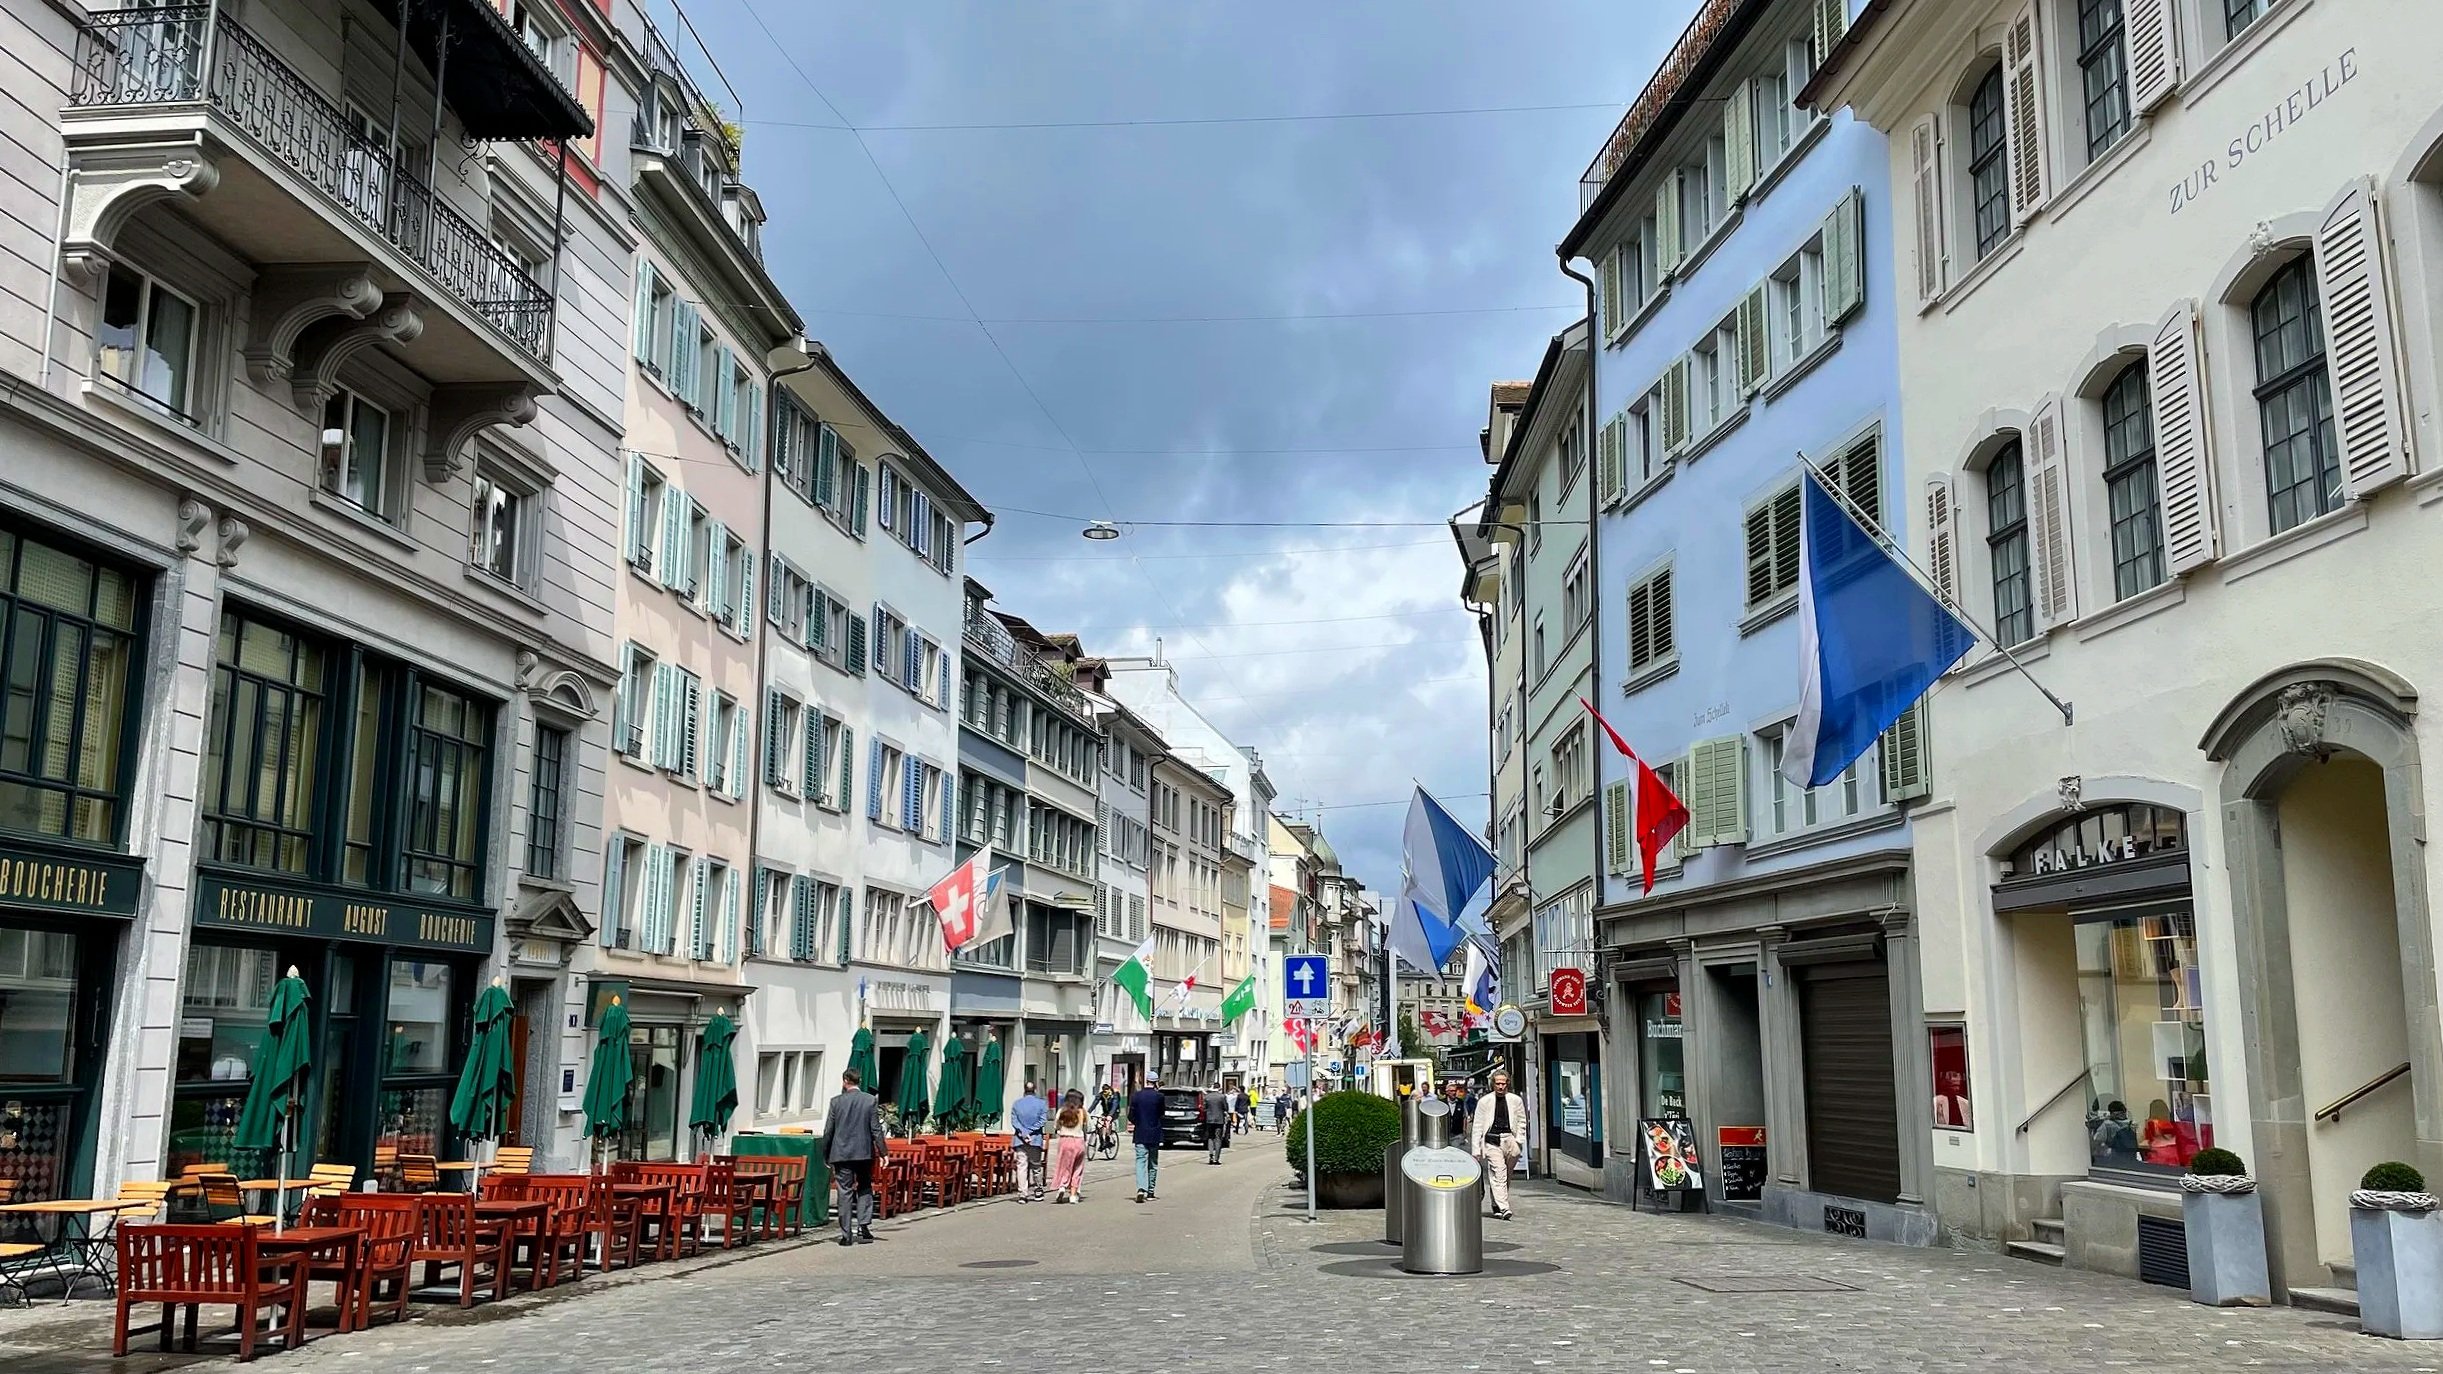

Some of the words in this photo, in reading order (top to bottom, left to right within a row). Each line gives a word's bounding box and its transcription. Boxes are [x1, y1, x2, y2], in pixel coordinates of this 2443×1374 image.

[2169, 159, 2219, 215] ZUR
[2227, 47, 2359, 170] SCHELLE
[2035, 835, 2135, 875] FALKE
[0, 858, 107, 906] BOUCHERIE
[219, 887, 313, 928] RESTAURANT
[419, 913, 476, 944] BOUCHERIE
